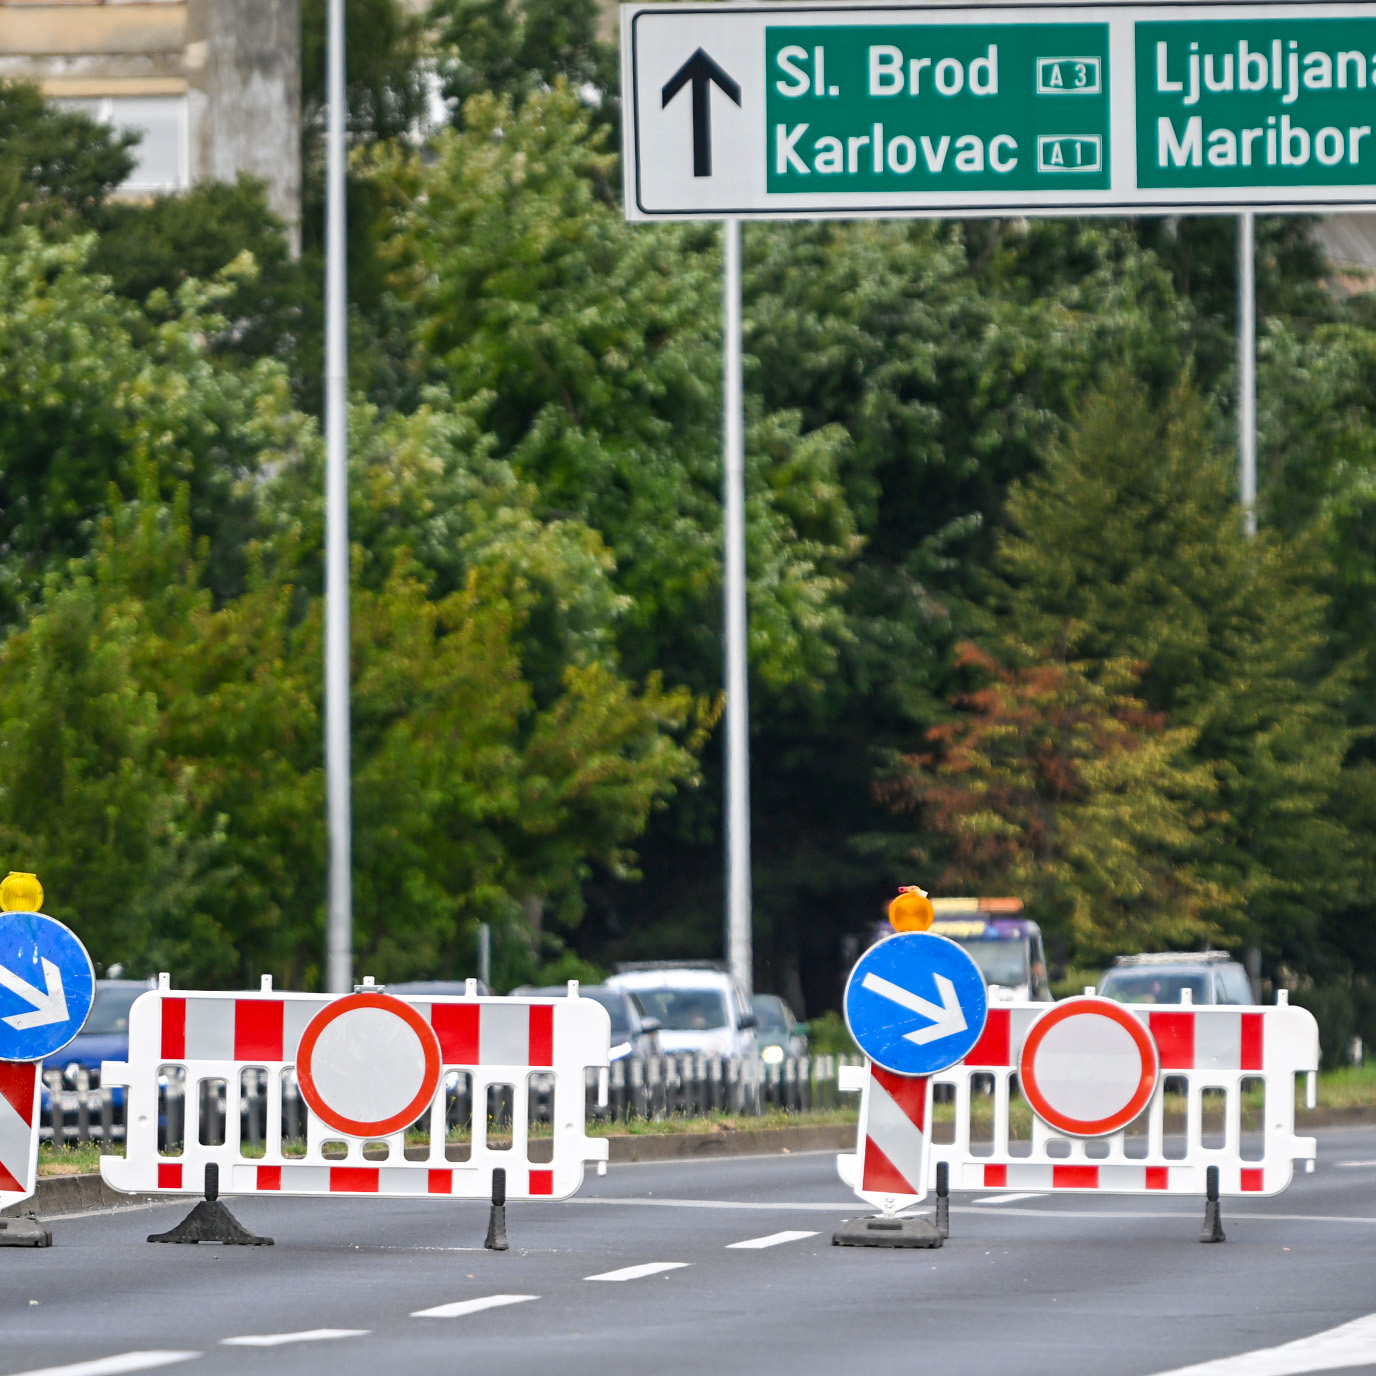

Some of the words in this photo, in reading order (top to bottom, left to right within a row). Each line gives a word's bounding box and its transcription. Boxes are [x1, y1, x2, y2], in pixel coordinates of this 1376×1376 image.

[775, 45, 840, 97] Sl.
[868, 43, 999, 97] Brod
[775, 122, 1019, 174] Karlovac
[1157, 114, 1372, 168] Maribor
